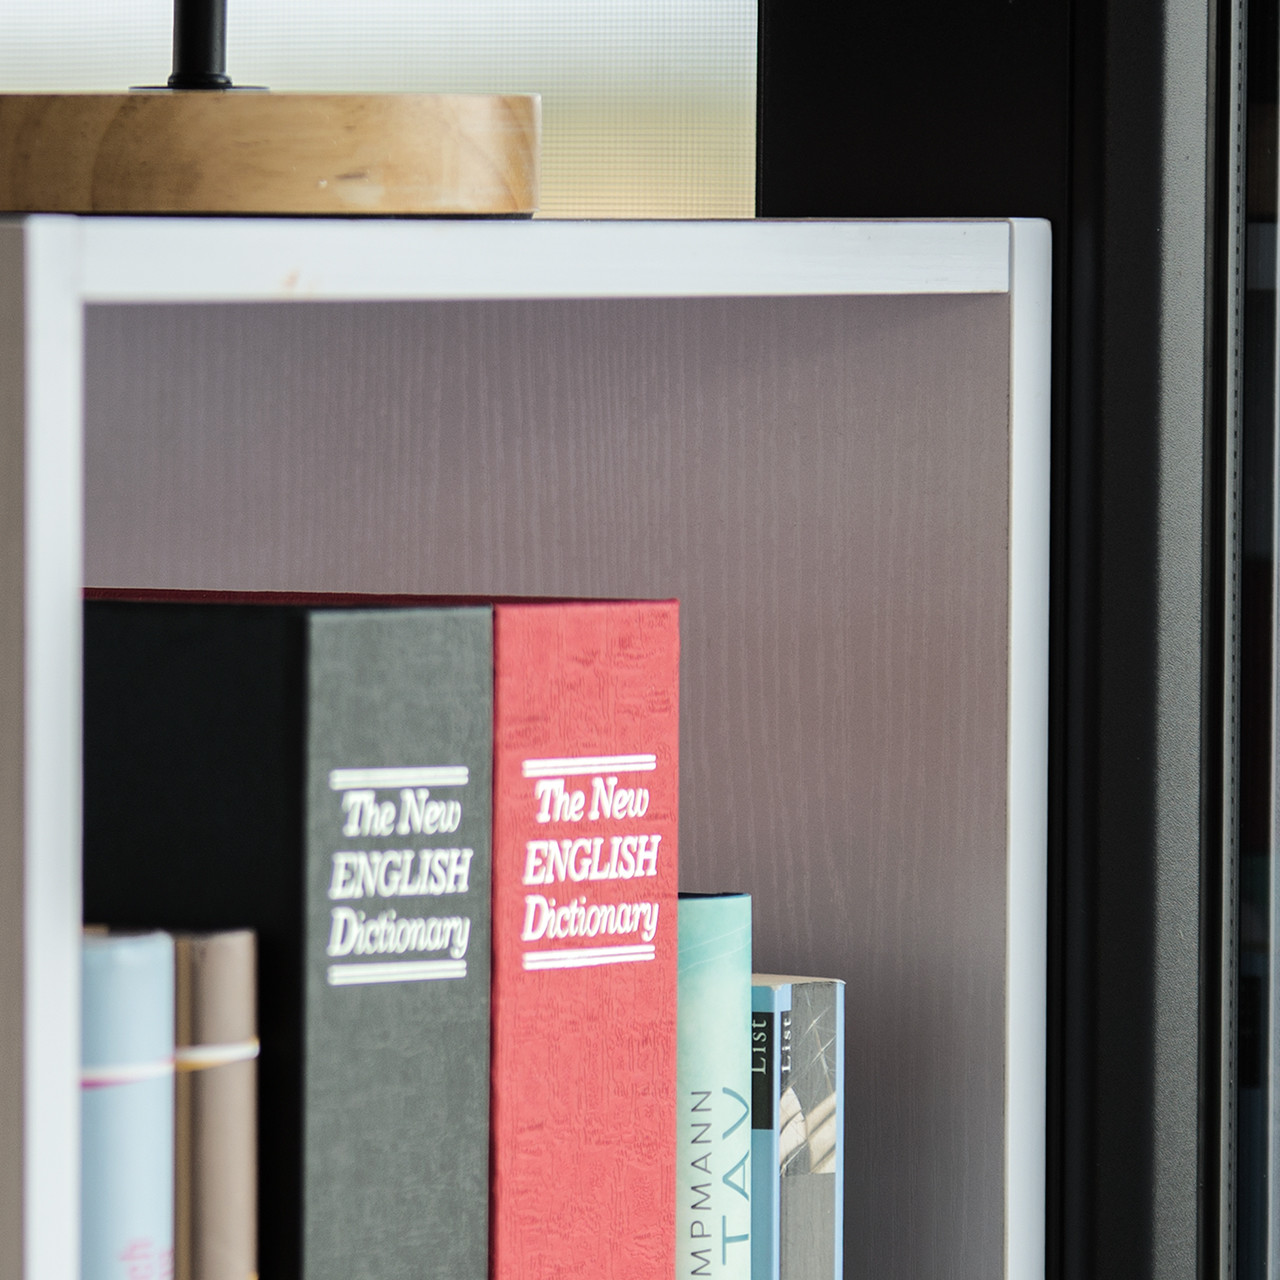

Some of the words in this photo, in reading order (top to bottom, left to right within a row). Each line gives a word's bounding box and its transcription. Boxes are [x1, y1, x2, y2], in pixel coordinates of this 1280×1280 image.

[342, 790, 395, 836] The
[396, 788, 461, 835] New
[535, 778, 584, 822] The
[588, 777, 649, 820] New
[328, 849, 473, 899] ENGLISH
[523, 835, 661, 884] ENGLISH
[327, 907, 470, 959] Dictionary
[521, 895, 658, 942] Dictionary
[752, 1019, 767, 1075] List
[781, 1017, 792, 1073] List
